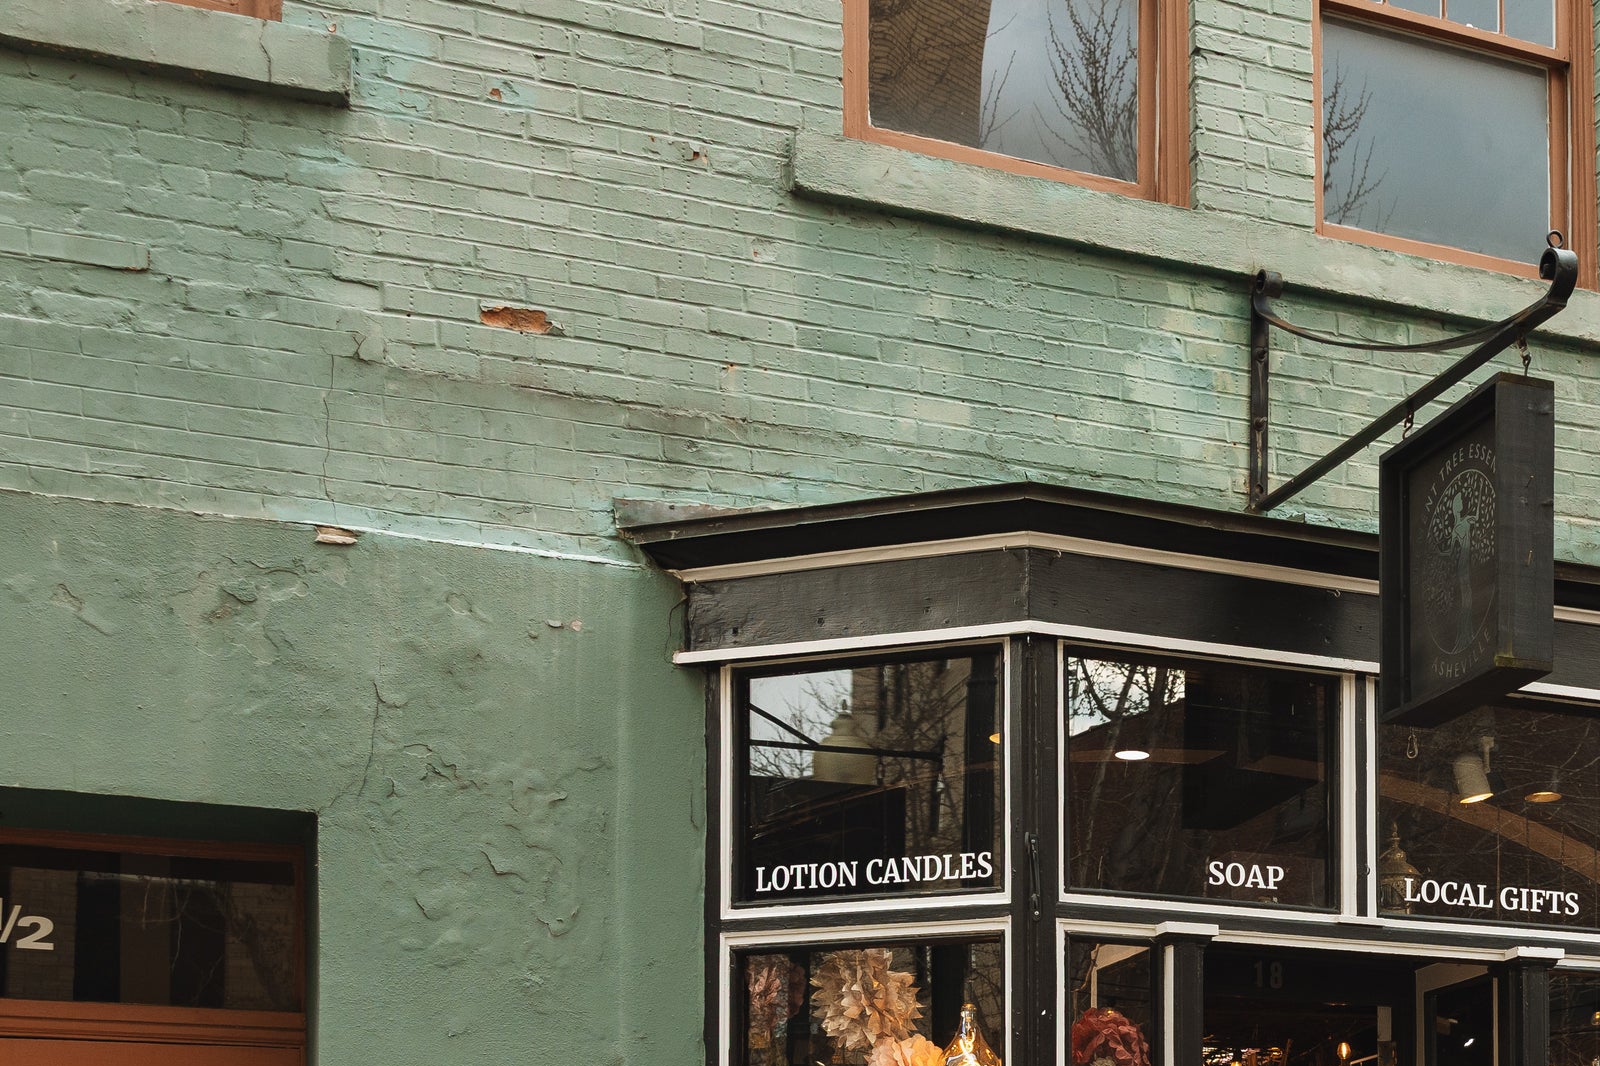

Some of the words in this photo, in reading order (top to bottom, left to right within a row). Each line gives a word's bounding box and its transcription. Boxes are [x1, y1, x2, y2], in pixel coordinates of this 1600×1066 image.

[1439, 447, 1465, 481] TREE
[756, 861, 859, 892] LOTION
[866, 851, 993, 885] CANDLES
[1209, 861, 1285, 890] SOAP
[1404, 877, 1494, 909] LOCAL
[1500, 887, 1580, 916] GIFTS
[1253, 960, 1285, 989] 18
